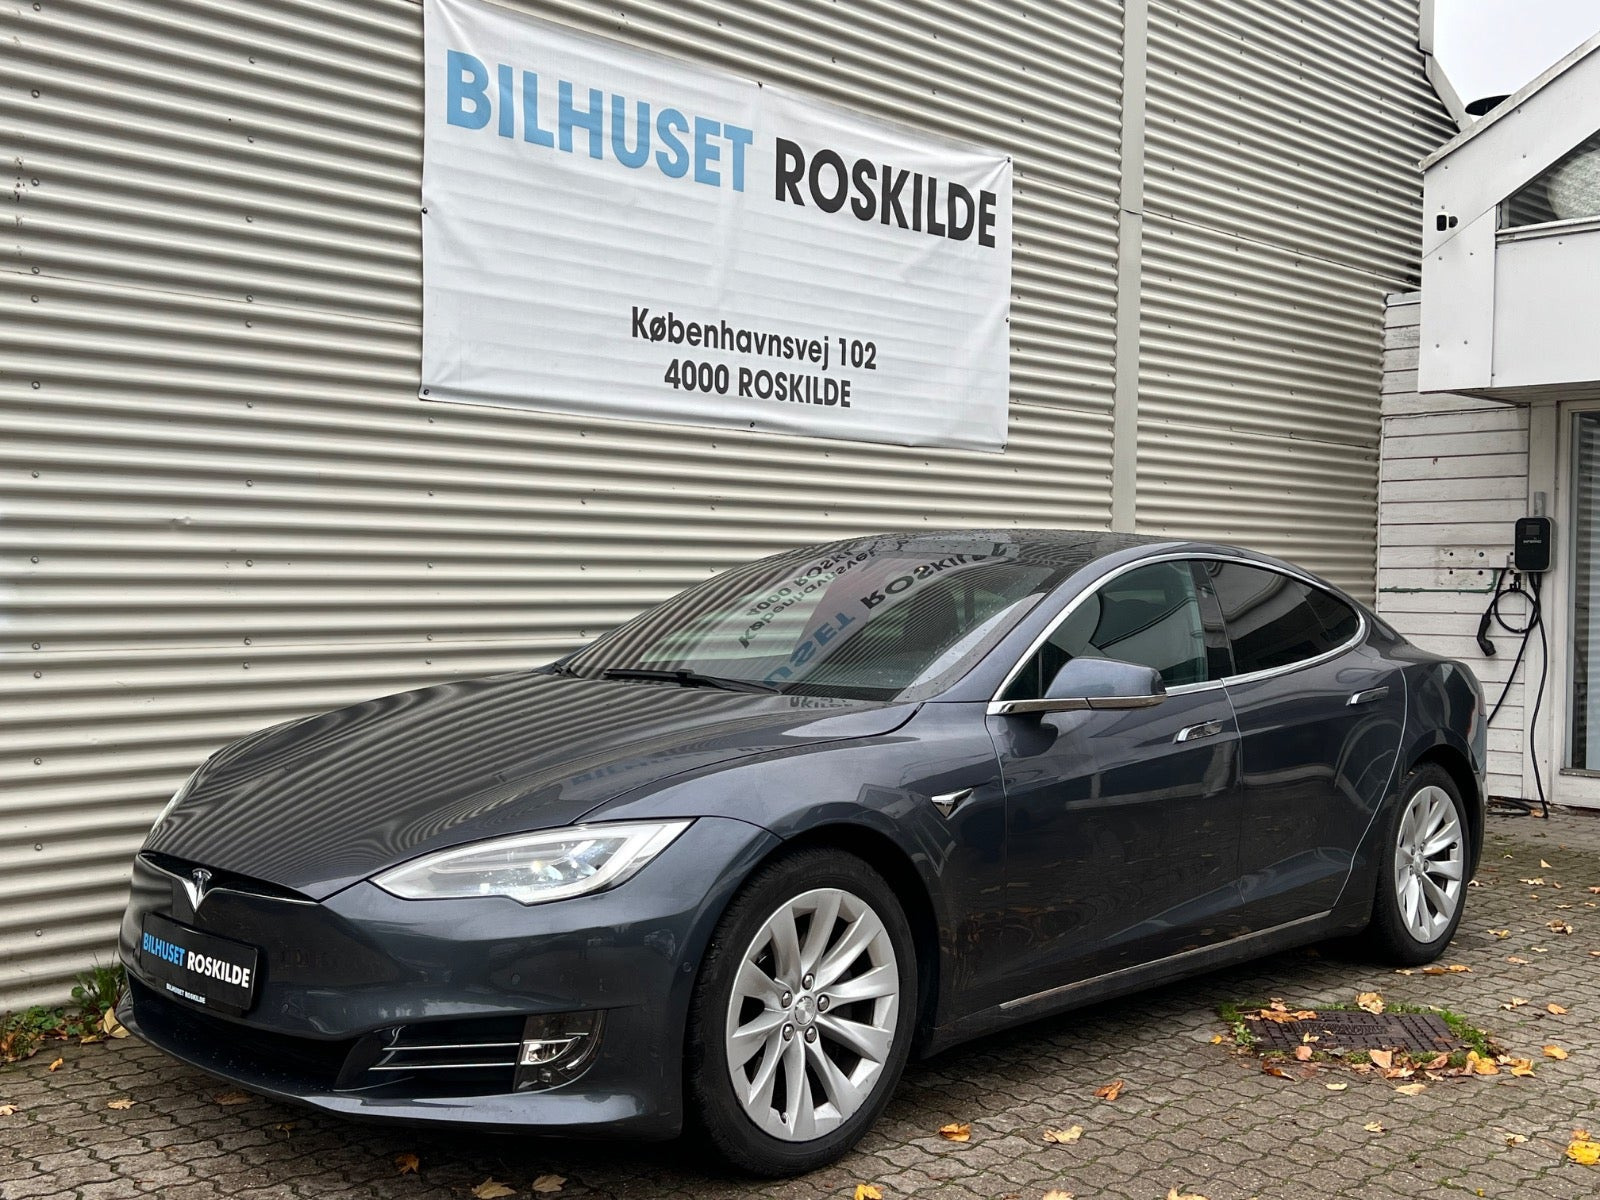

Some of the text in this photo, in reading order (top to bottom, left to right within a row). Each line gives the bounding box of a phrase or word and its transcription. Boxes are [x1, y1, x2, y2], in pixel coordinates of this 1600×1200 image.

[446, 49, 997, 249] BILHUSET ROSKILDE
[632, 306, 877, 371] Københavnsvej 102
[664, 358, 851, 408] 4000 ROSKILDE
[143, 932, 250, 988] BILHUSET ROSKILDE
